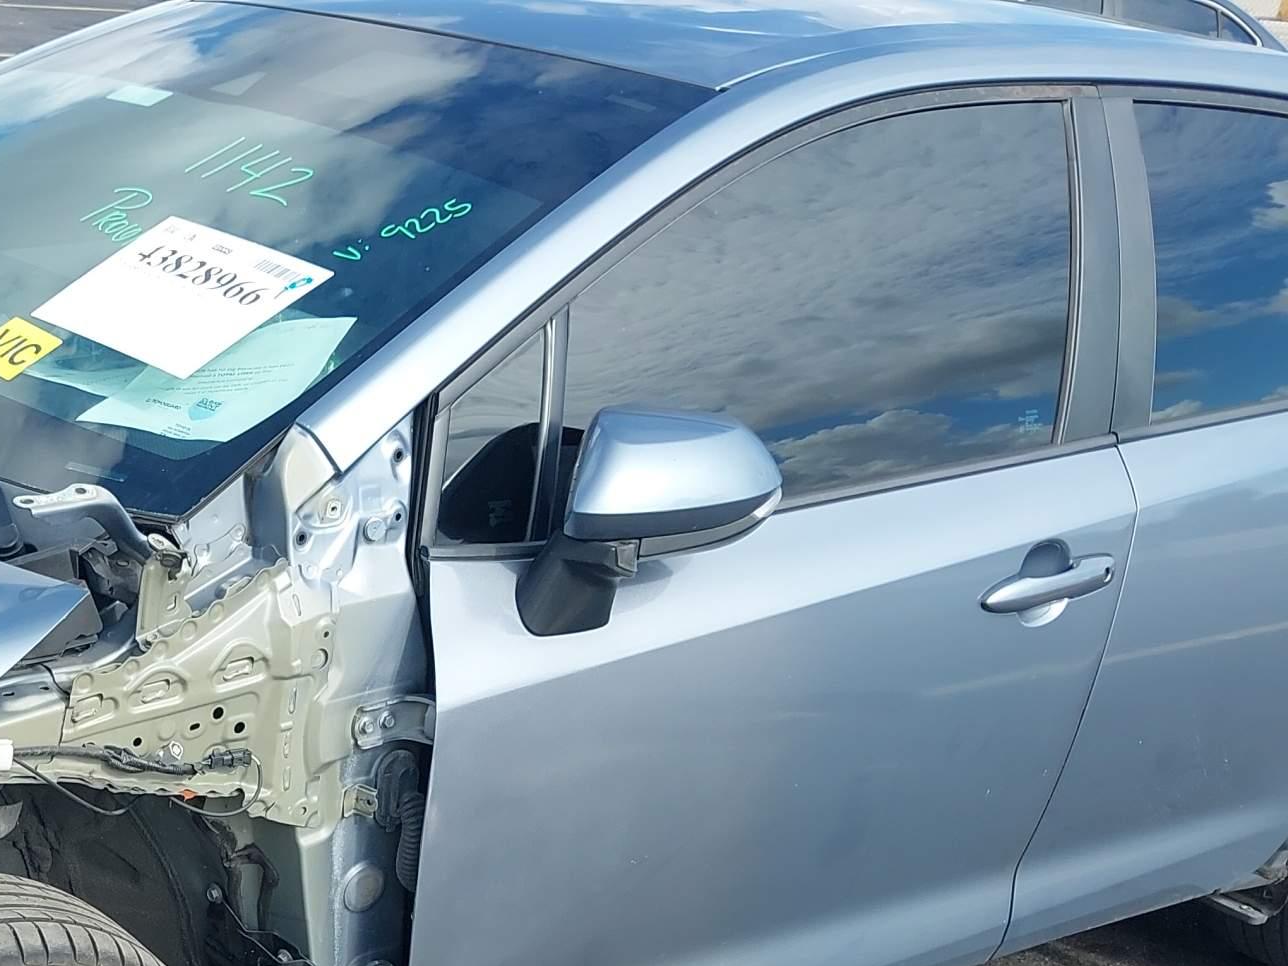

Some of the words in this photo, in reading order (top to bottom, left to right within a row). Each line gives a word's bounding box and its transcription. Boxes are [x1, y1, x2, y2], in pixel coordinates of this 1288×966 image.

[184, 136, 314, 207] 1142
[380, 198, 472, 239] 9225
[136, 244, 270, 306] 43828966
